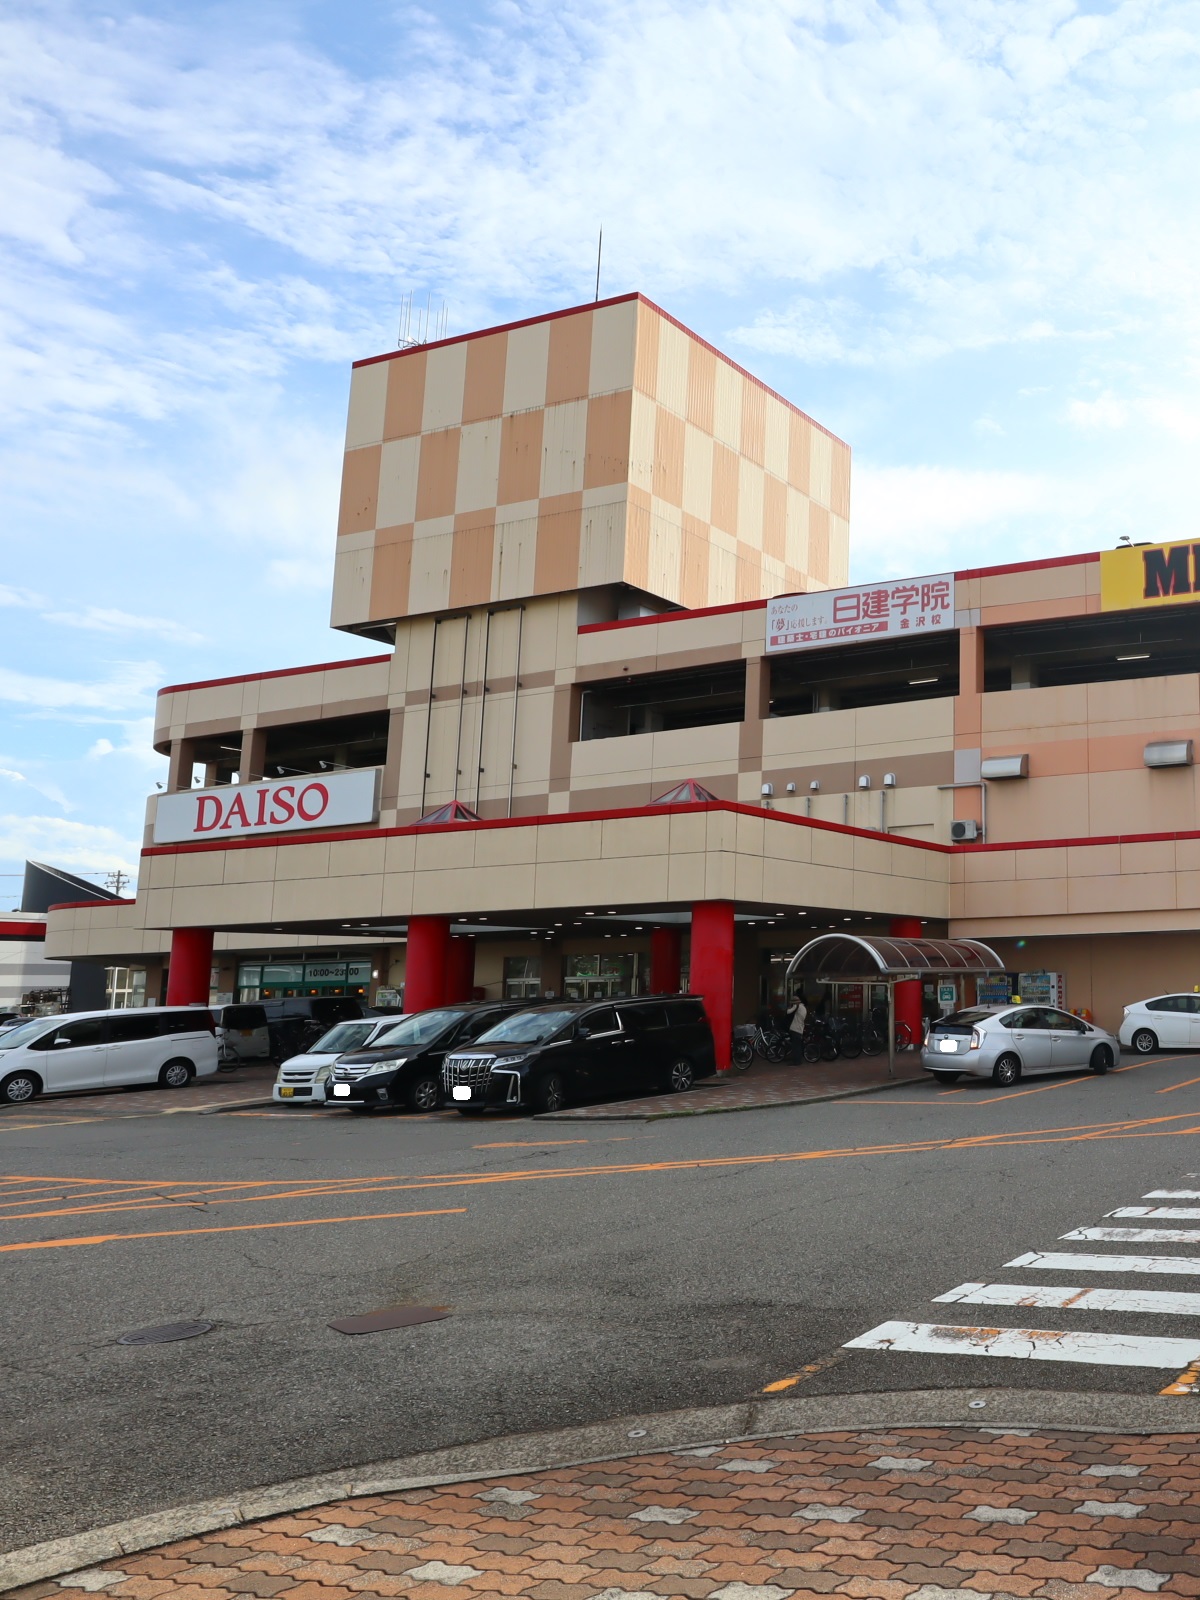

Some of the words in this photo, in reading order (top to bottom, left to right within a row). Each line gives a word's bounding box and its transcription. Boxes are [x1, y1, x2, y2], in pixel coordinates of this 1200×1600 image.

[771, 603, 798, 615] あなたの
[833, 580, 950, 624] 日建学院
[900, 613, 942, 629] 金沢校
[193, 782, 329, 832] DAISO
